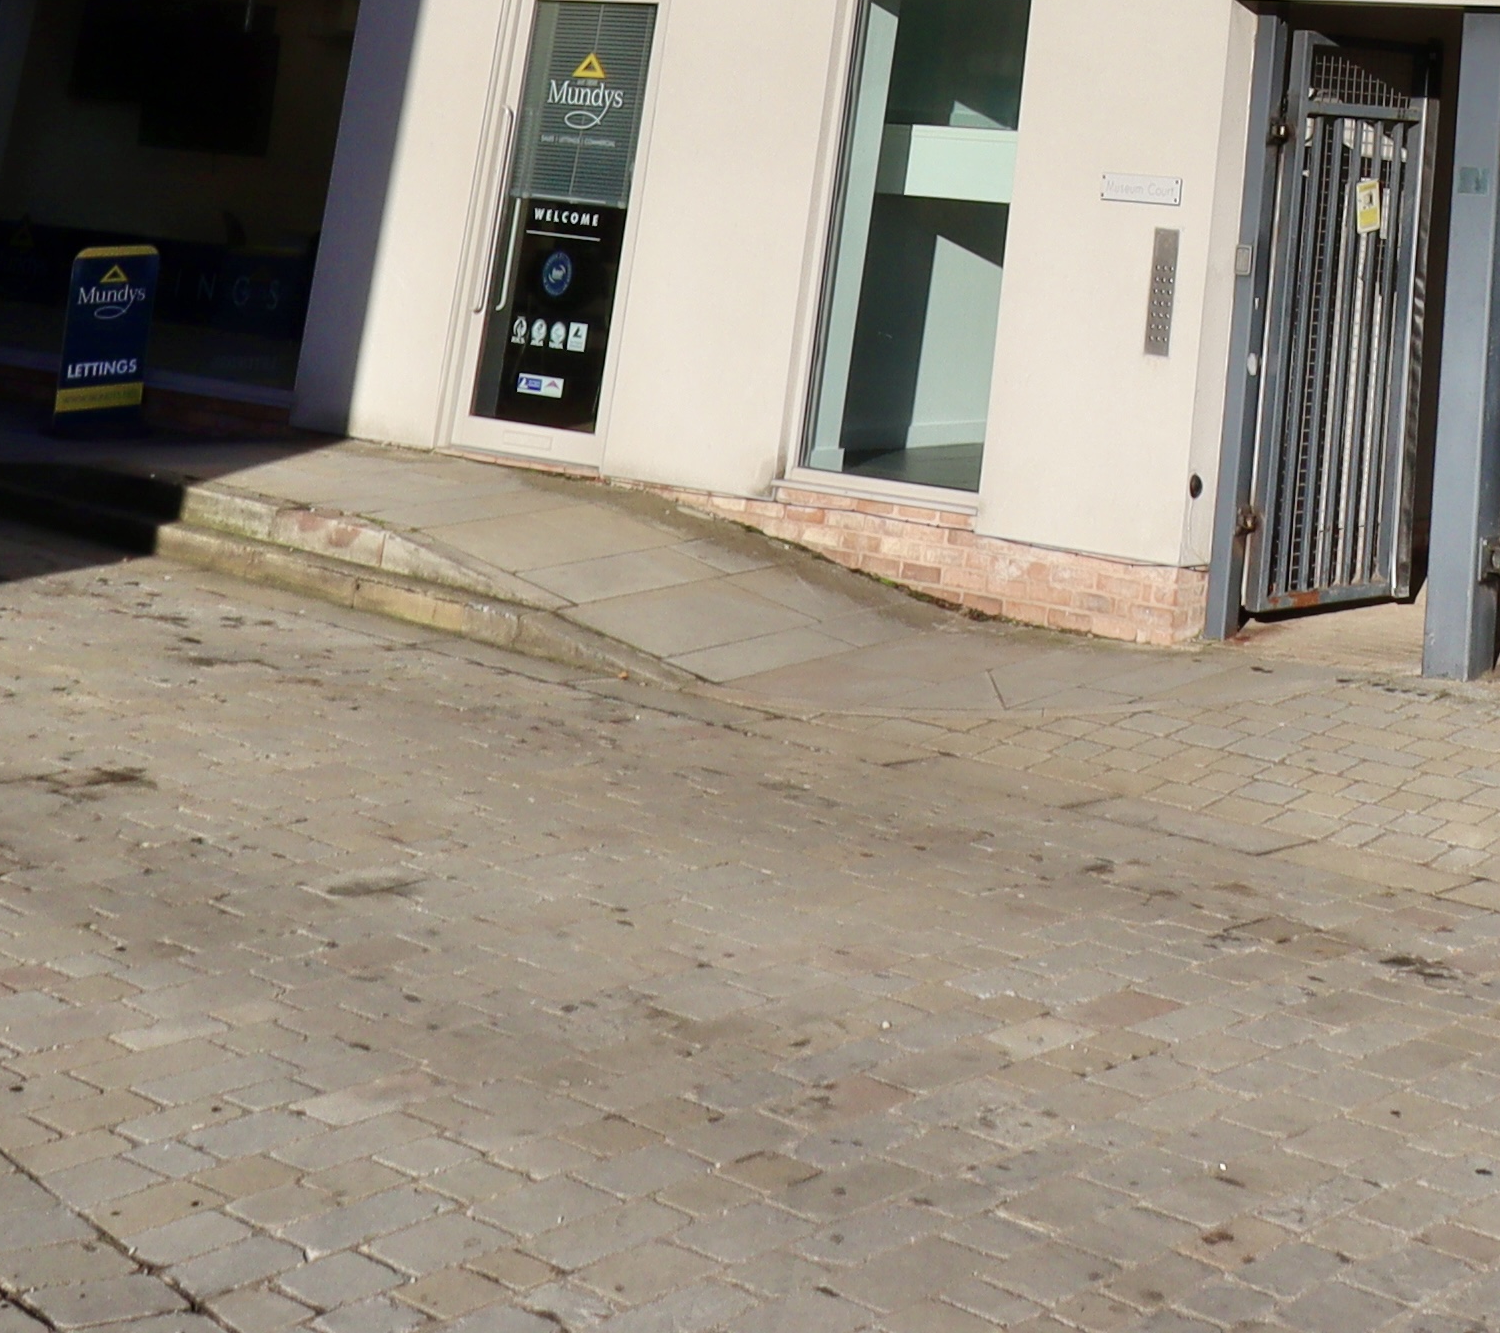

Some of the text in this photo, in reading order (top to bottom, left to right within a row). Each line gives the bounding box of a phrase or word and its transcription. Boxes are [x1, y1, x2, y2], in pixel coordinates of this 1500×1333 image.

[547, 79, 624, 129] Mundys
[1105, 179, 1174, 197] Museum Court
[534, 207, 600, 227] WELCOME
[77, 284, 146, 319] Mundys
[67, 358, 138, 379] LETTINGS
